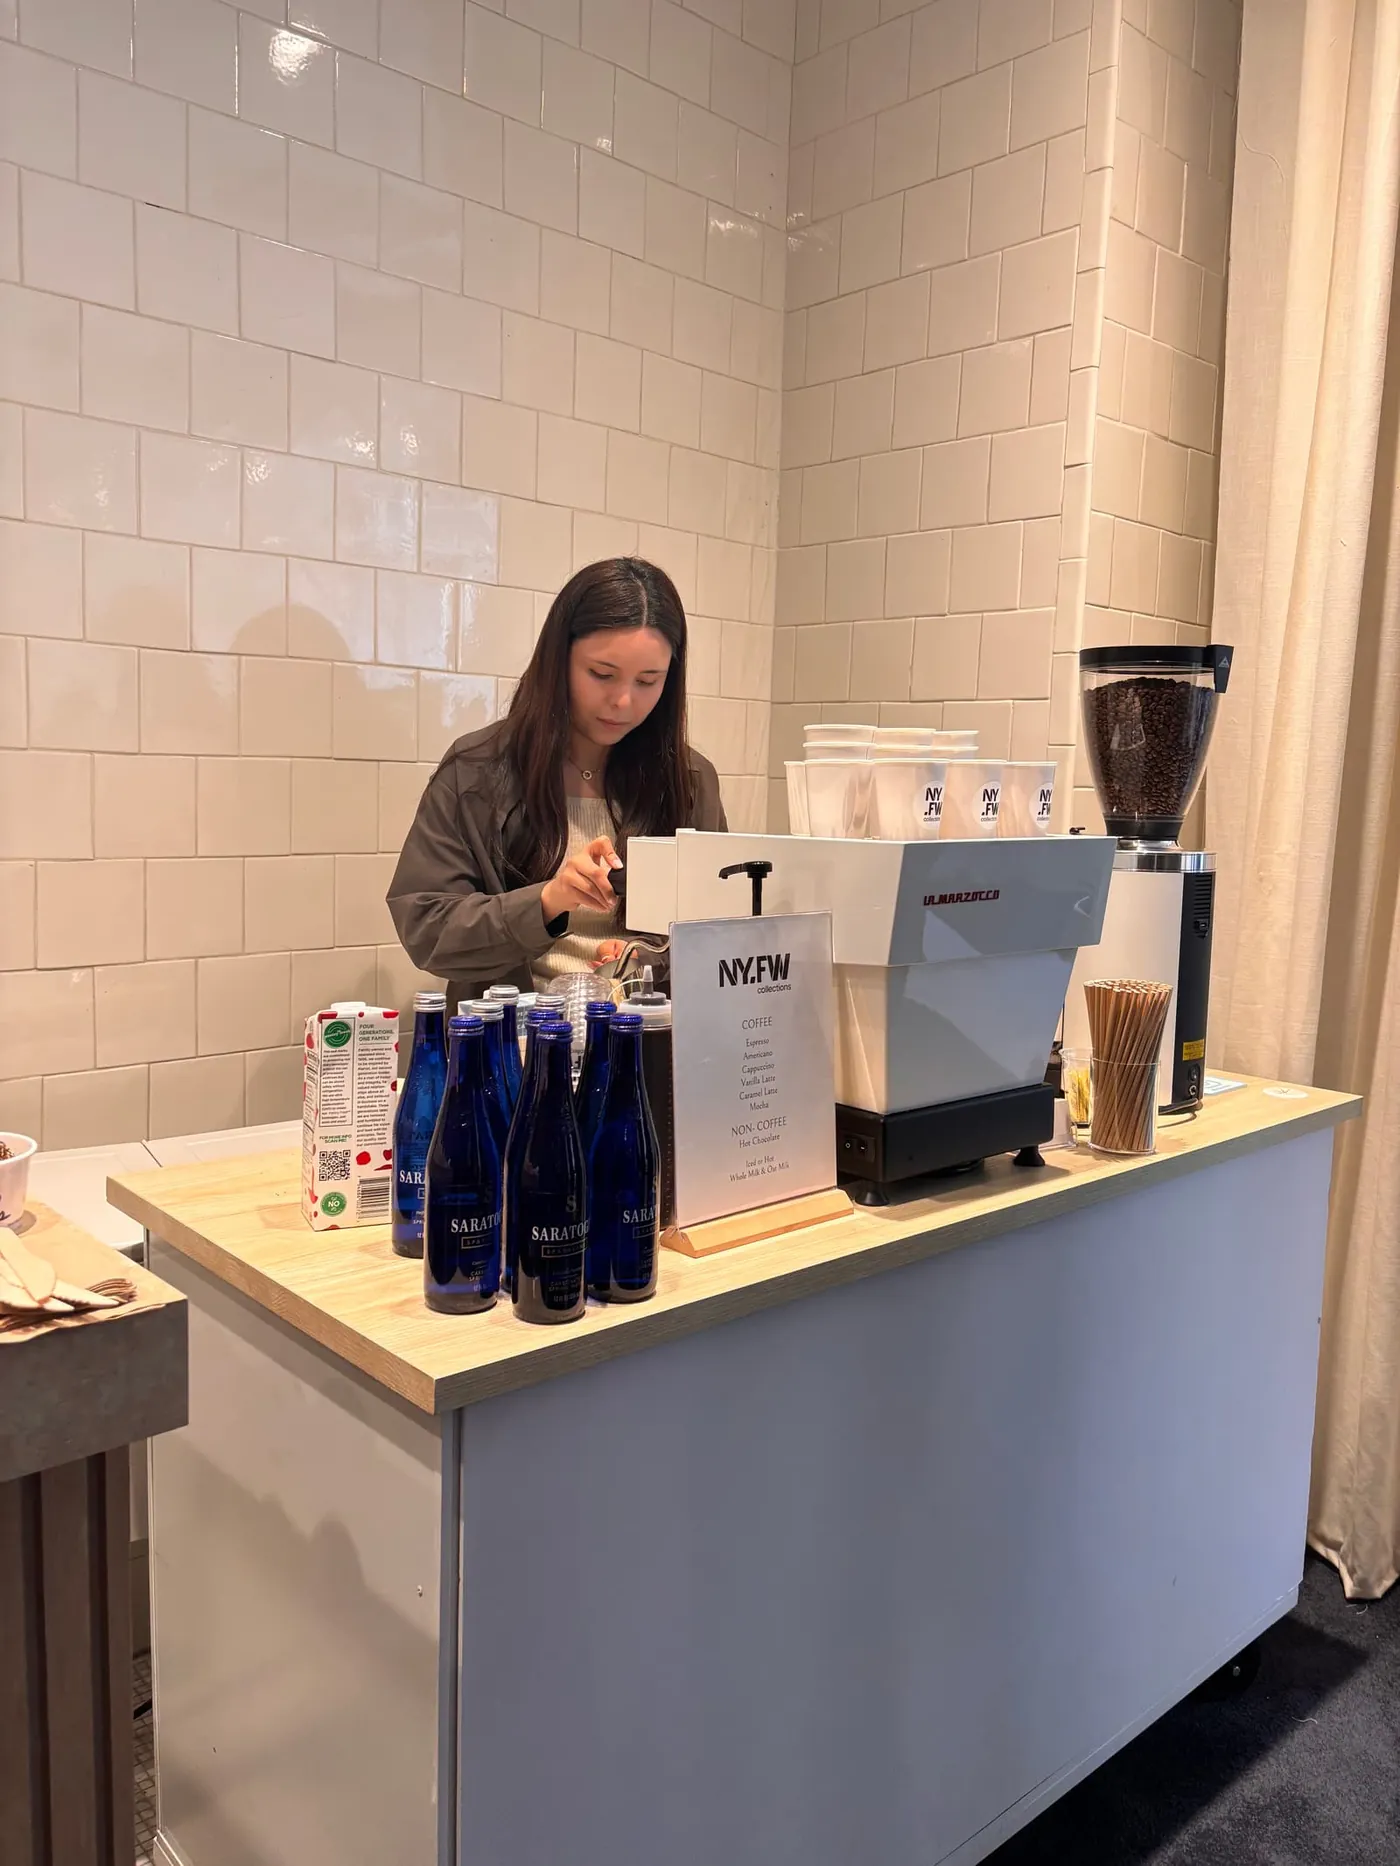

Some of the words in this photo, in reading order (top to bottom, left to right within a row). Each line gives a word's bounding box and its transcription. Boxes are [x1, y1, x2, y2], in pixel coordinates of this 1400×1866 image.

[925, 787, 942, 801] NY
[982, 788, 1000, 802] NY
[719, 953, 790, 988] NY.FW
[757, 983, 792, 994] collections
[741, 1016, 773, 1030] COFFEE
[745, 1038, 769, 1048] Espresso
[743, 1050, 773, 1060] Americano
[741, 1062, 775, 1075] Cappuccino
[740, 1076, 760, 1087] Vanilla
[761, 1075, 776, 1084] Latte
[739, 1088, 763, 1100] Caramel
[764, 1087, 778, 1096] Latte
[749, 1101, 769, 1111] Mocha
[731, 1122, 755, 1137] NON-
[756, 1116, 787, 1131] COFFEE
[739, 1139, 751, 1148] Hot
[752, 1133, 780, 1146] Chocolate
[745, 1158, 757, 1168] Iced
[764, 1155, 775, 1164] Hot
[399, 1169, 425, 1185] SAR
[729, 1171, 747, 1182] Whole
[748, 1168, 760, 1178] Milk
[327, 1200, 340, 1208] NO
